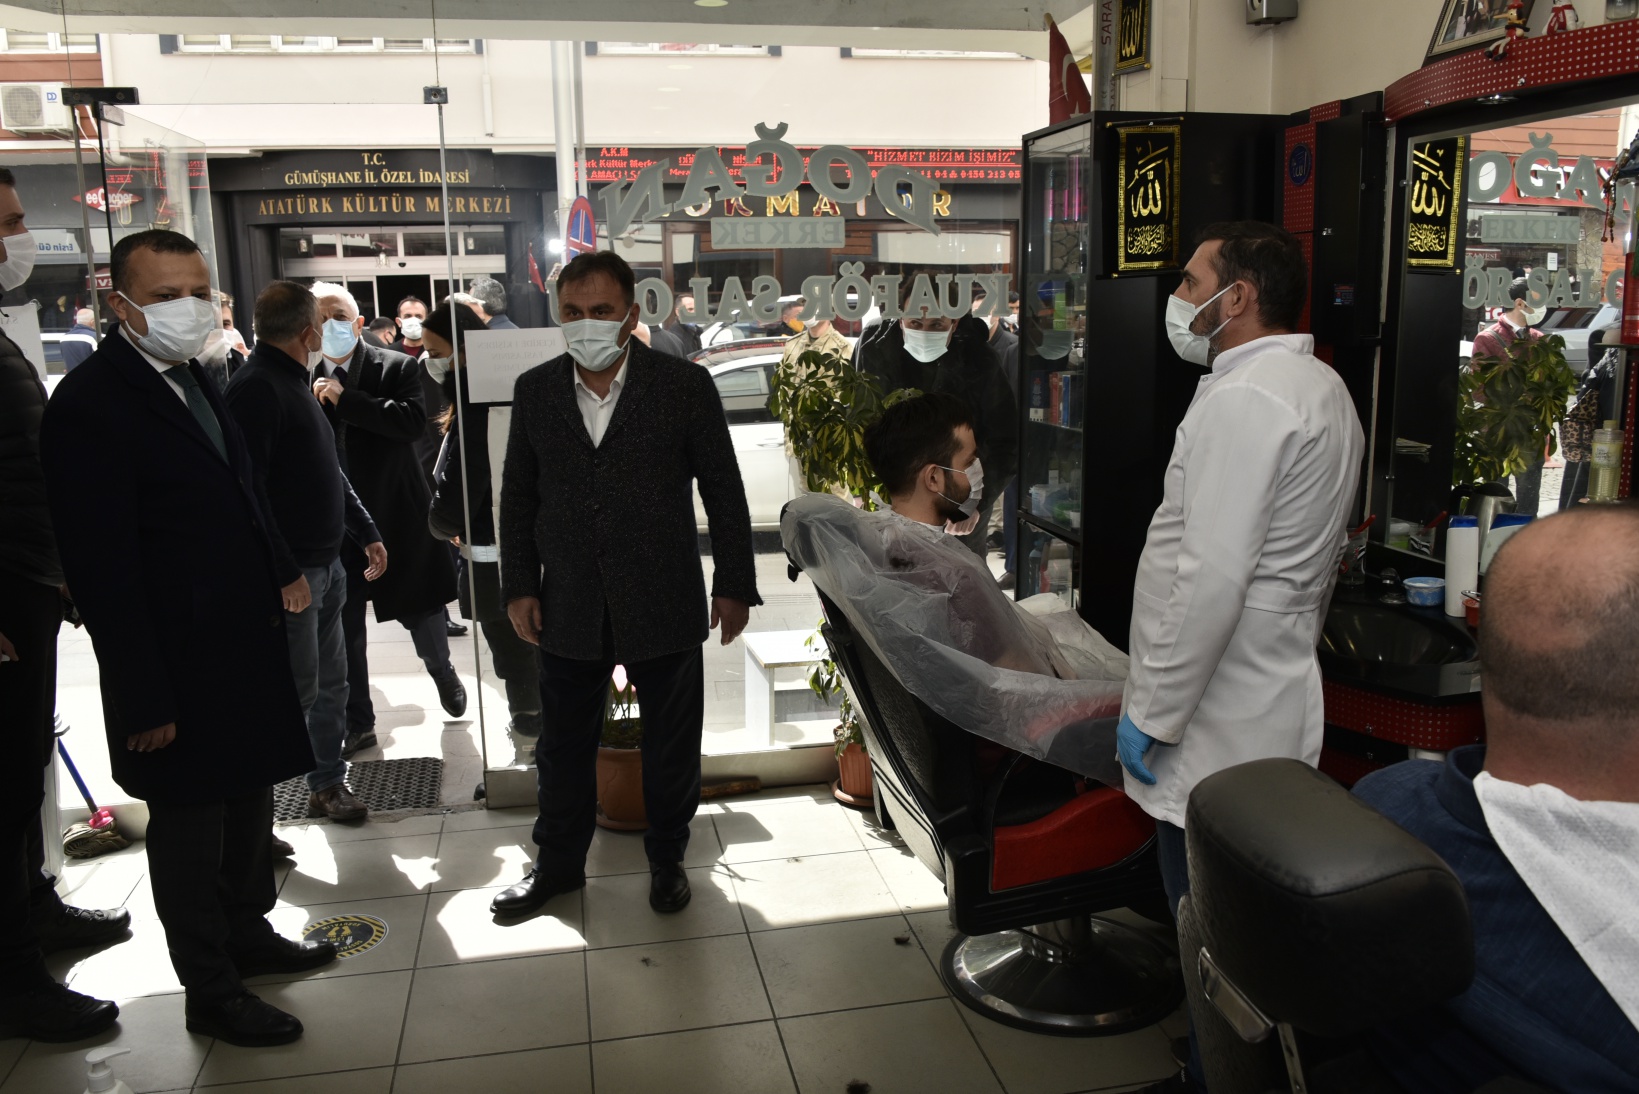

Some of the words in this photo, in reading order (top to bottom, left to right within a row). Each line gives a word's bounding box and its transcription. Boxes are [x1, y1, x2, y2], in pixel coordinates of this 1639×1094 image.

[361, 152, 386, 165] T.C.
[929, 149, 965, 162] BİZİM
[285, 170, 362, 187] GÜMÜŞHANE
[365, 168, 378, 183] İL
[381, 168, 415, 183] ÖZEL
[987, 170, 1006, 179] 213
[260, 194, 333, 216] ATATÜRK
[342, 193, 416, 213] KÜLTÜR
[1484, 220, 1579, 241] ERKEK
